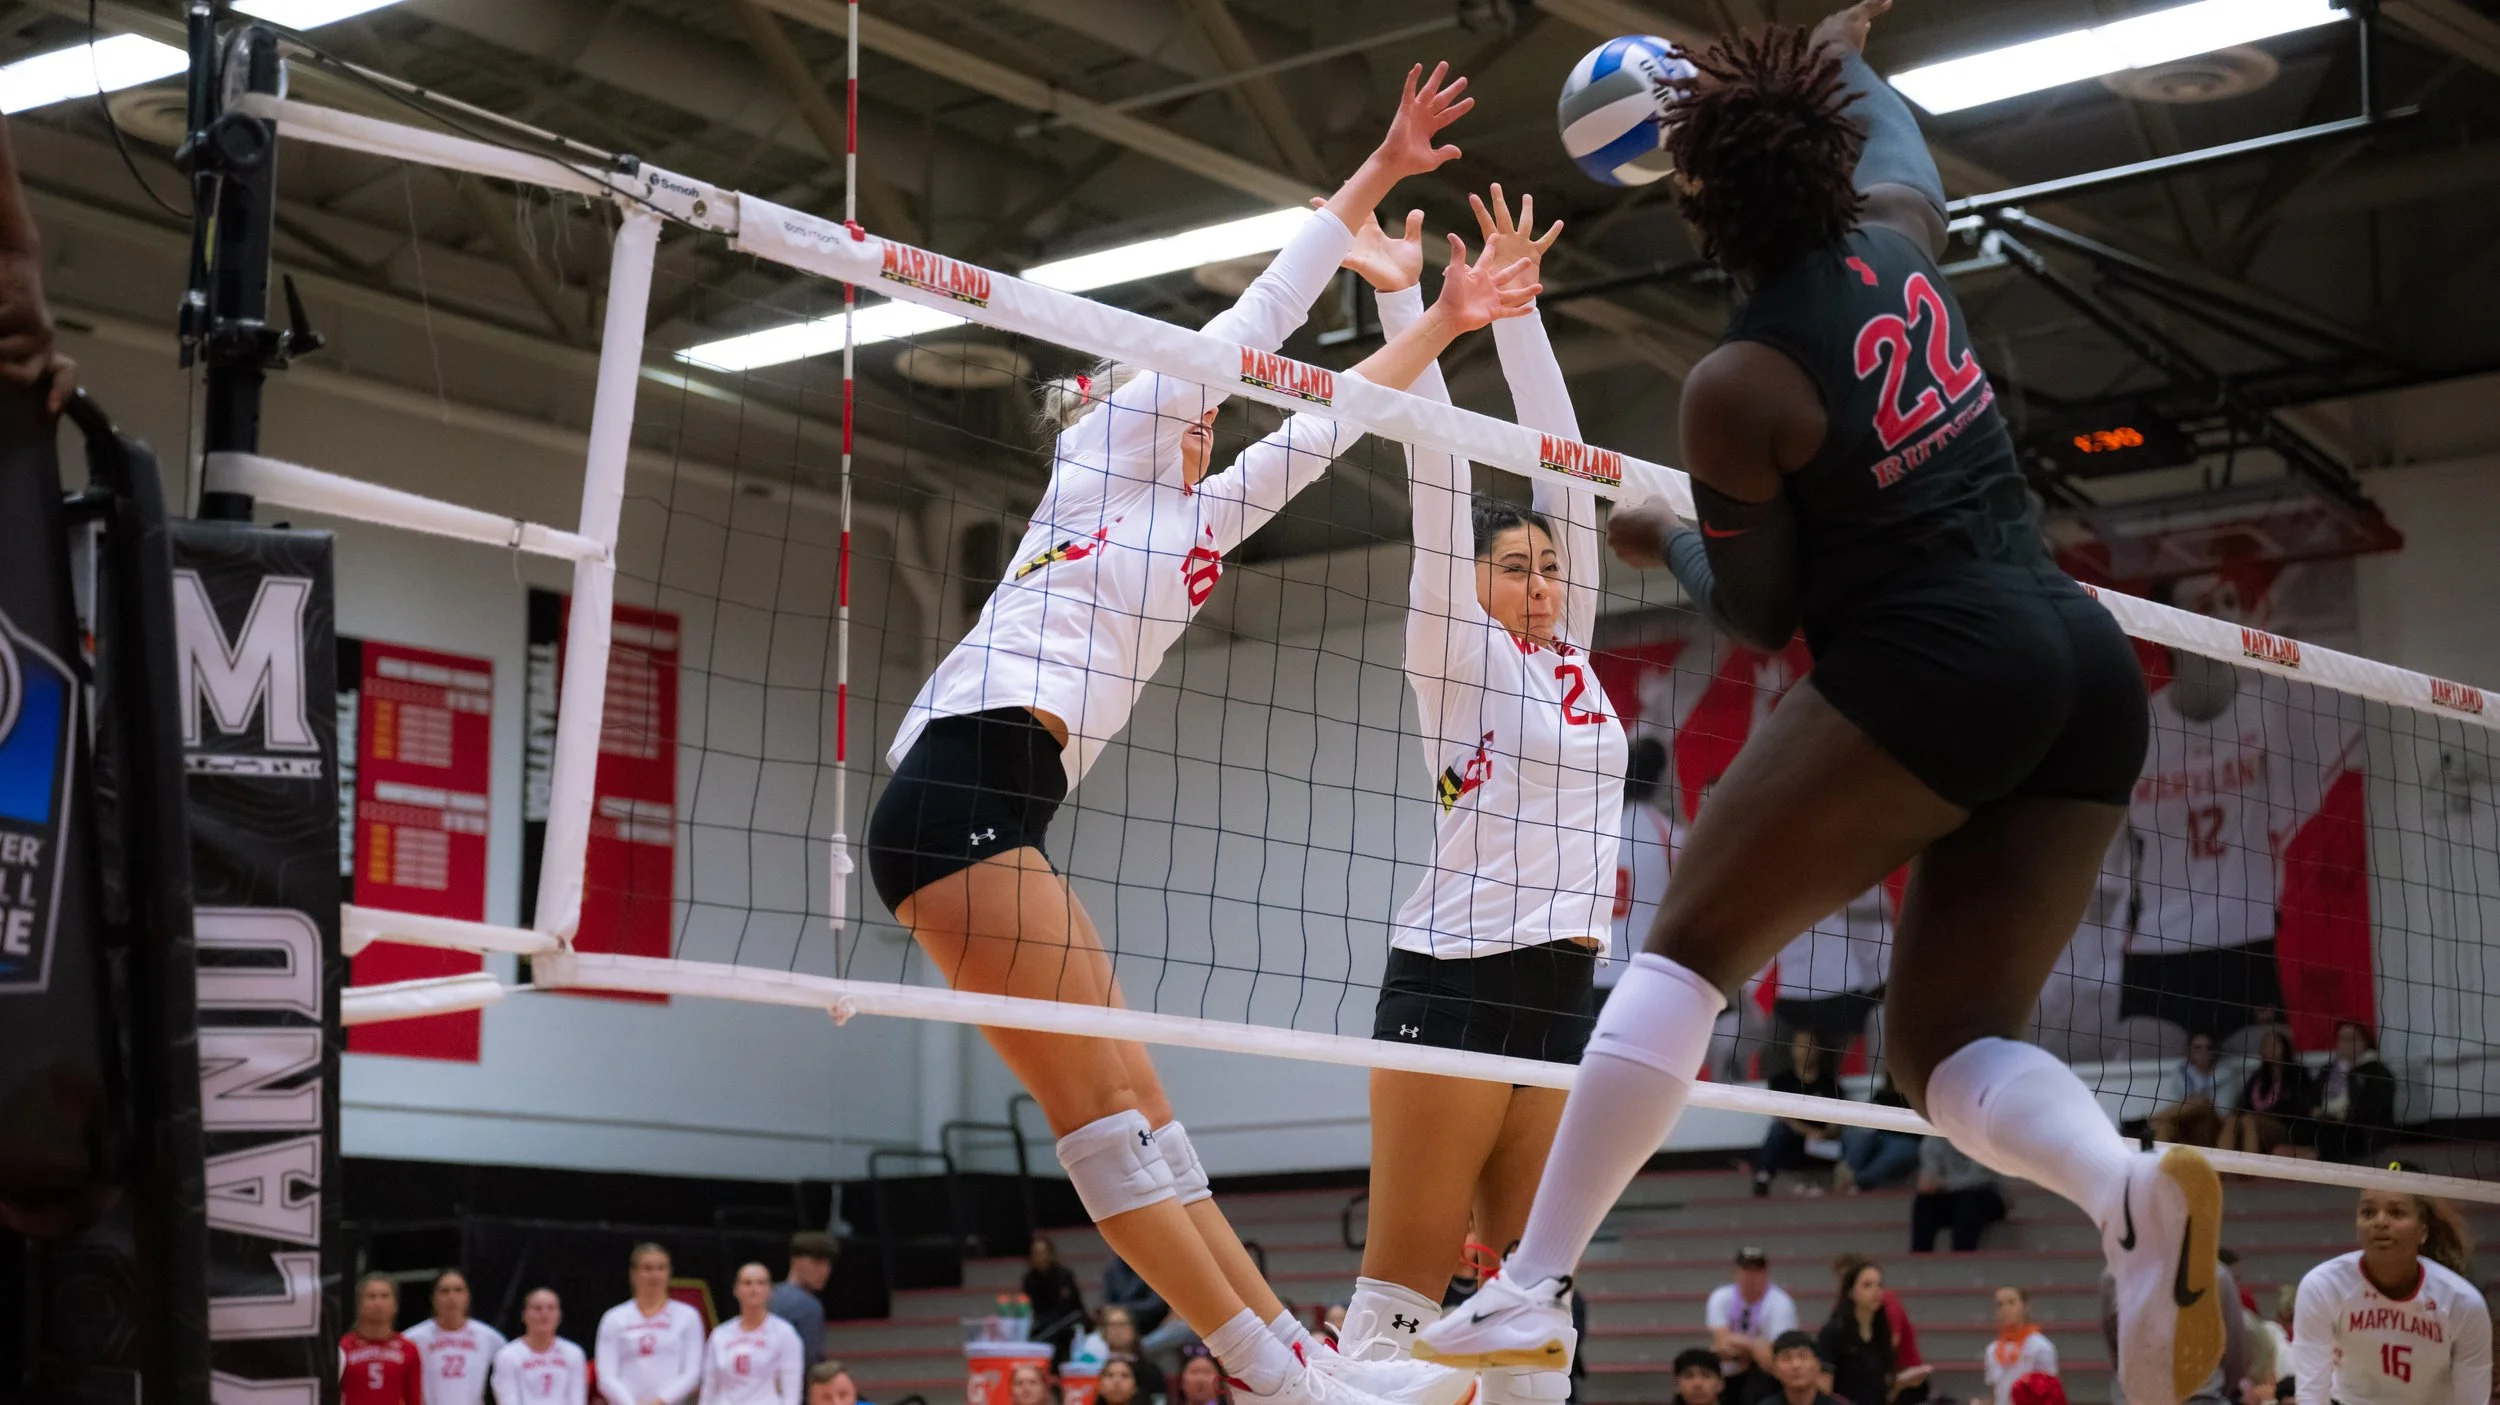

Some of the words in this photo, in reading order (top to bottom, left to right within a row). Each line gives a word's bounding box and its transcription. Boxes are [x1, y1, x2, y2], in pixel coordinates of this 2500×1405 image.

[661, 178, 700, 199] Senoh
[882, 239, 991, 300] MARYLAND
[1240, 345, 1334, 399] MARYLAND
[1854, 272, 1982, 451] 22
[1540, 433, 1622, 480] MARYLAND
[172, 568, 320, 752] M
[2241, 627, 2300, 664] MARYLAND
[1555, 664, 1608, 725] 2
[2188, 804, 2226, 861] 12
[2349, 1308, 2443, 1344] MARYLAND
[367, 1361, 384, 1390] 5
[441, 1355, 466, 1379] 22
[2381, 1343, 2413, 1385] 16
